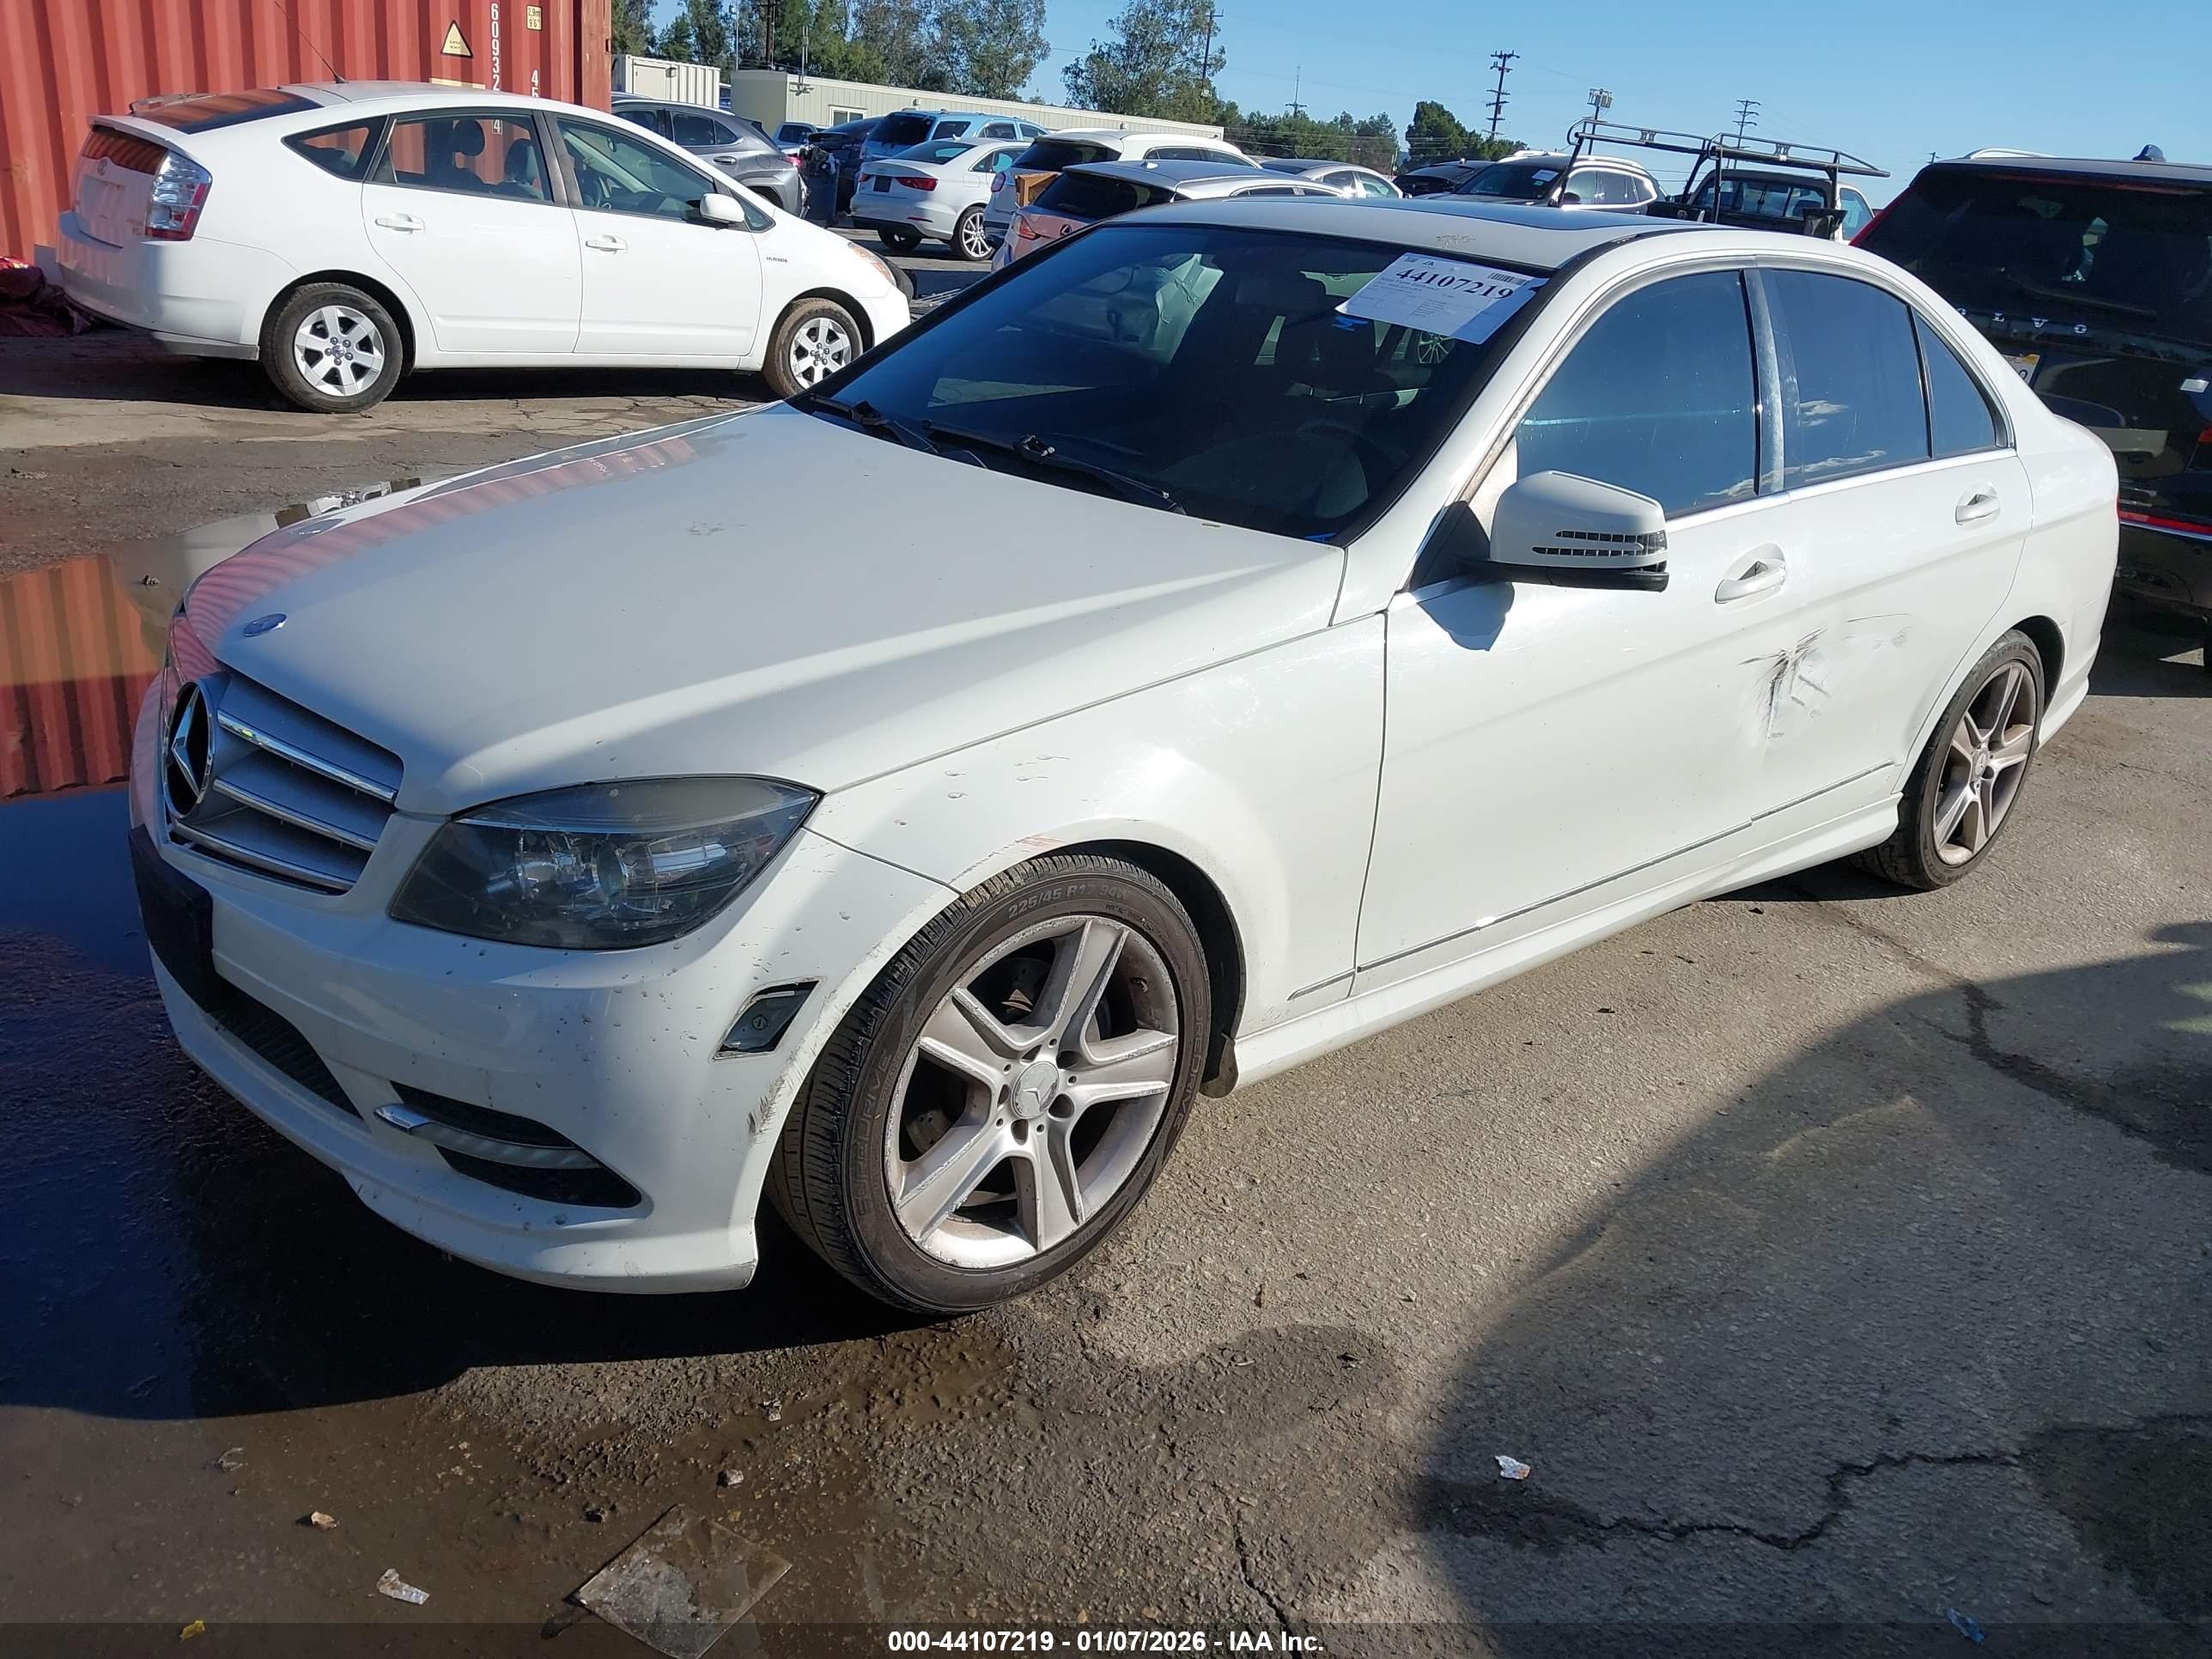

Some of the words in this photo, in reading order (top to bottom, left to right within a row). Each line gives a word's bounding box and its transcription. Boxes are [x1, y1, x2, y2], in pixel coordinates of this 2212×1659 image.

[1396, 268, 1515, 300] 44107219
[1008, 887, 1062, 920] 225/45
[1173, 988, 1204, 1132] SUREDRIVE
